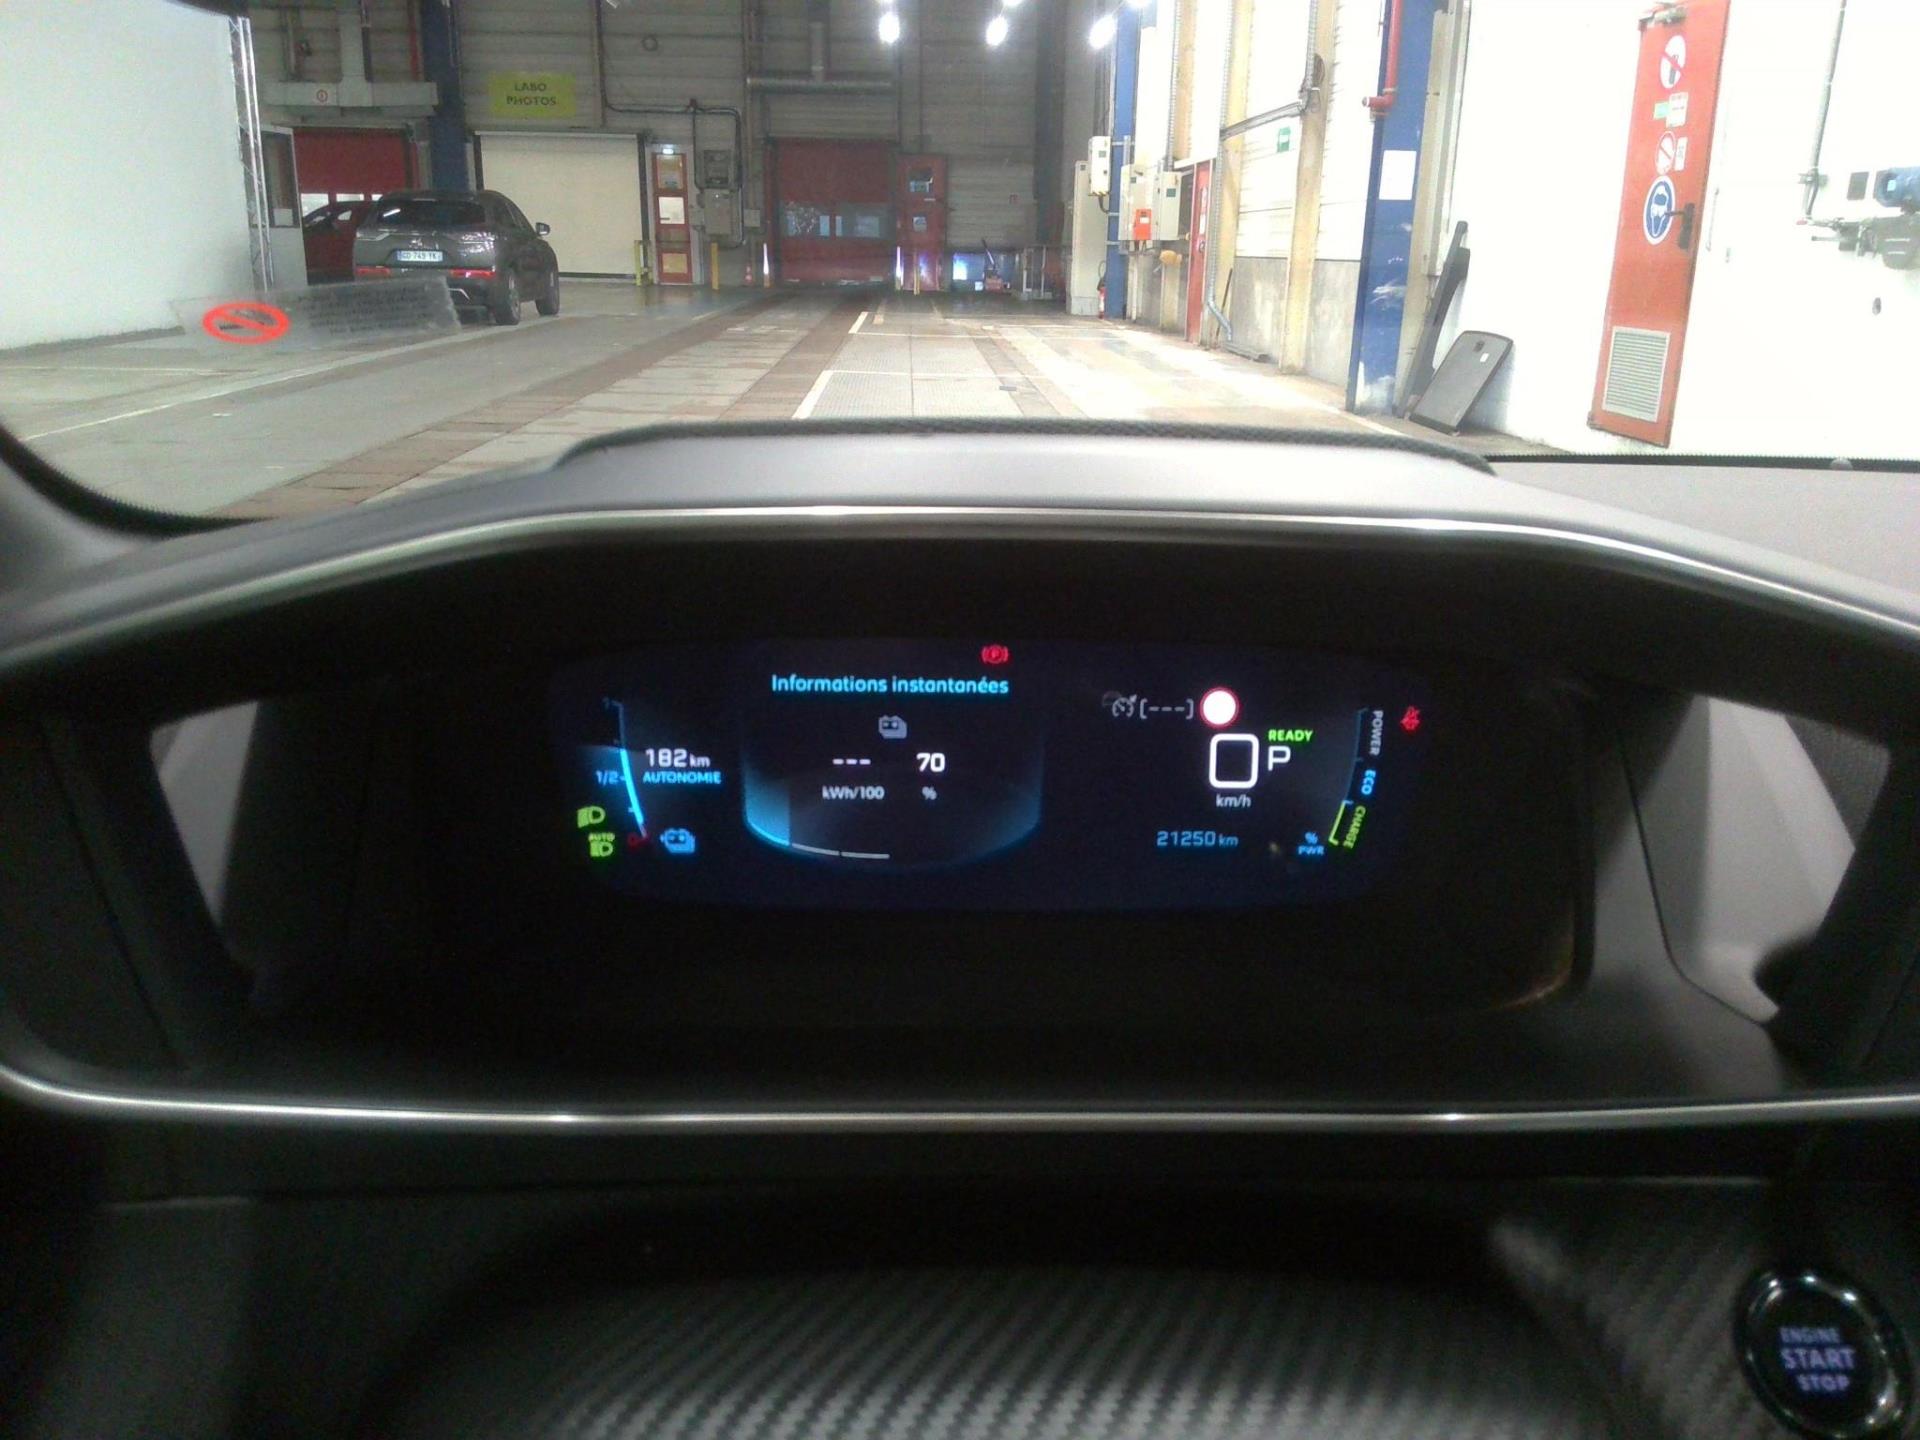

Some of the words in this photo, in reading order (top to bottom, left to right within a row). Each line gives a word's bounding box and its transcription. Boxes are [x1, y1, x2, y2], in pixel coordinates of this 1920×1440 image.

[514, 82, 547, 92] LABO
[506, 96, 557, 106] PHOTOS
[771, 673, 888, 693] Informations
[892, 675, 1010, 694] instantanées
[1267, 729, 1314, 743] READY
[1369, 709, 1384, 757] POWER
[645, 748, 688, 768] 182
[689, 754, 711, 768] km
[916, 752, 946, 773] 70
[1208, 733, 1260, 789] 0
[1267, 745, 1292, 772] P
[643, 770, 722, 785] AUTONOMIE
[1361, 769, 1377, 796] ECO
[821, 785, 885, 801] kWh/100
[1215, 793, 1252, 808] km/h
[1343, 805, 1367, 850] CHARGE
[1156, 830, 1217, 848] 21250
[1218, 834, 1240, 848] km
[1778, 1326, 1841, 1344] ENGINE
[1780, 1347, 1856, 1370] START
[1797, 1373, 1850, 1392] STOP
